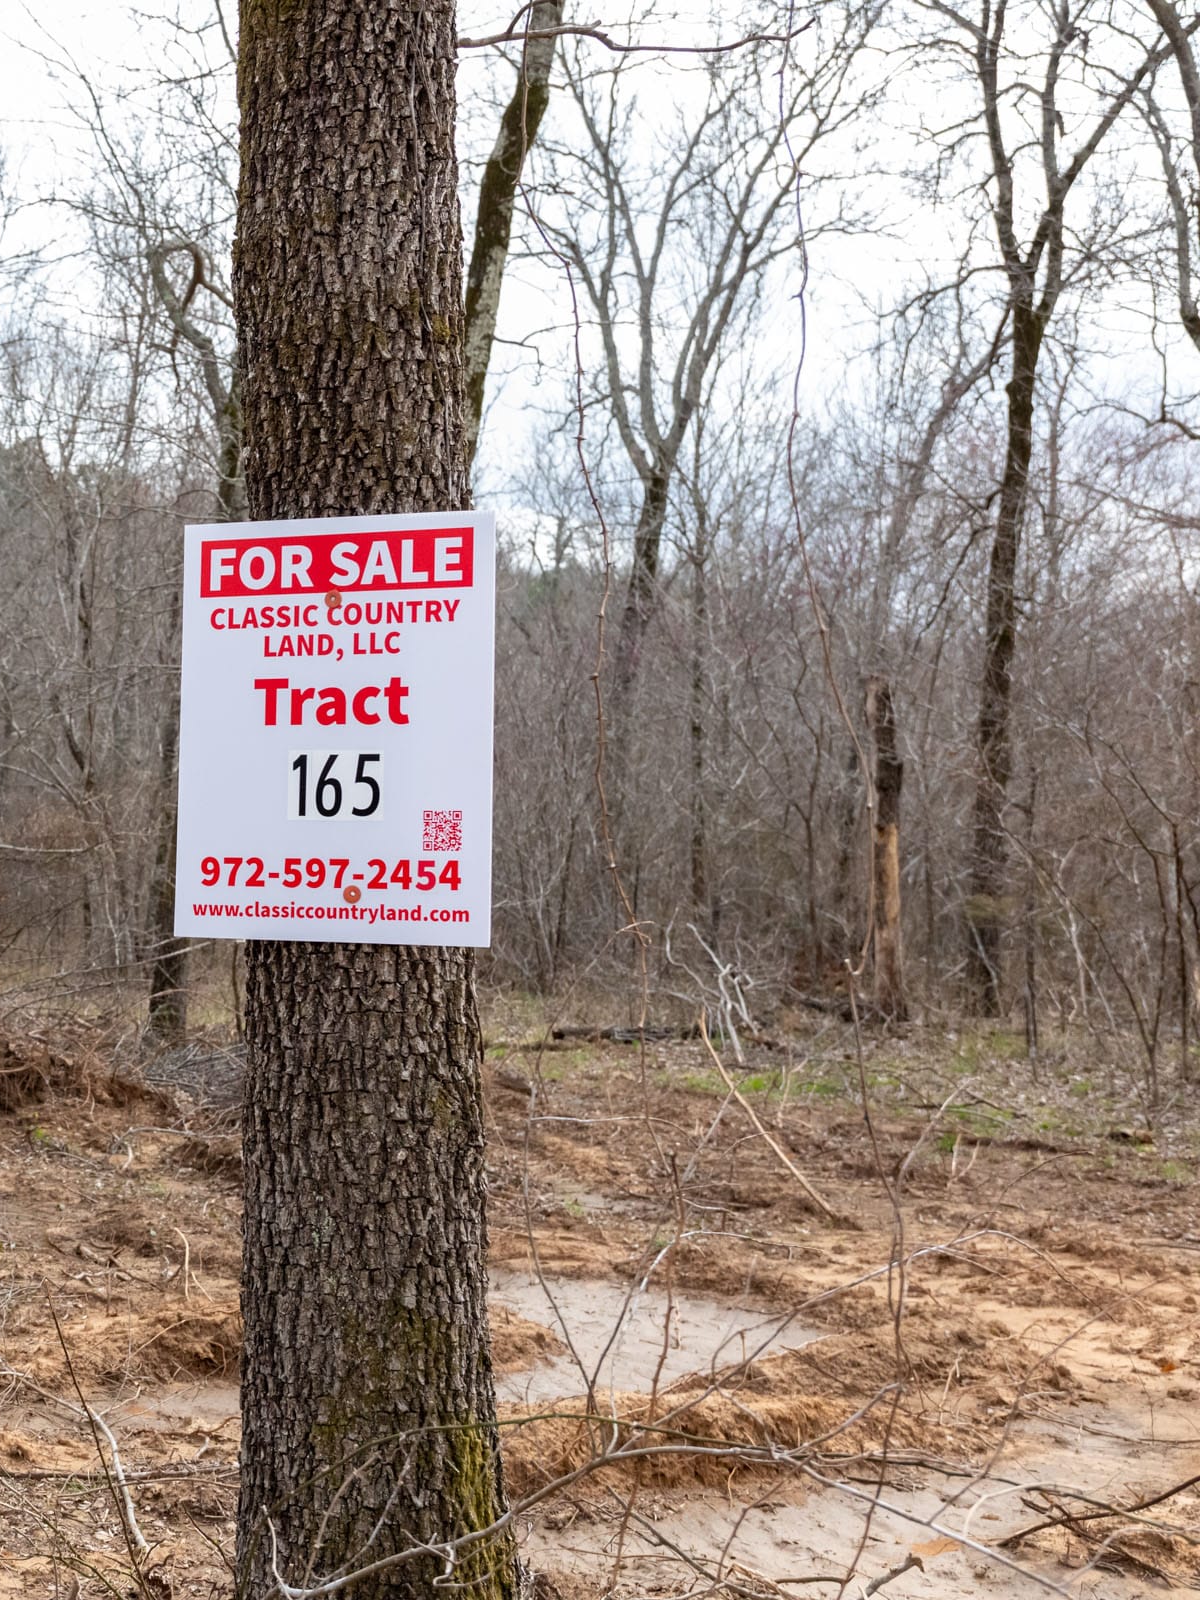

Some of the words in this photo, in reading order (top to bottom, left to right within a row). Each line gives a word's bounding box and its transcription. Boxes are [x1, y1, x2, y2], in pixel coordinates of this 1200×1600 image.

[209, 545, 314, 592] FOR
[328, 536, 463, 587] SALE
[210, 604, 319, 630] CLASSIC
[326, 599, 460, 627] COUNTRY
[263, 633, 345, 661] LAND,
[353, 631, 401, 655] LLC
[254, 676, 410, 727] Tract
[292, 753, 381, 818] 165
[200, 855, 462, 892] 972-597-2454
[192, 901, 471, 925] www.classiccountryland.com
